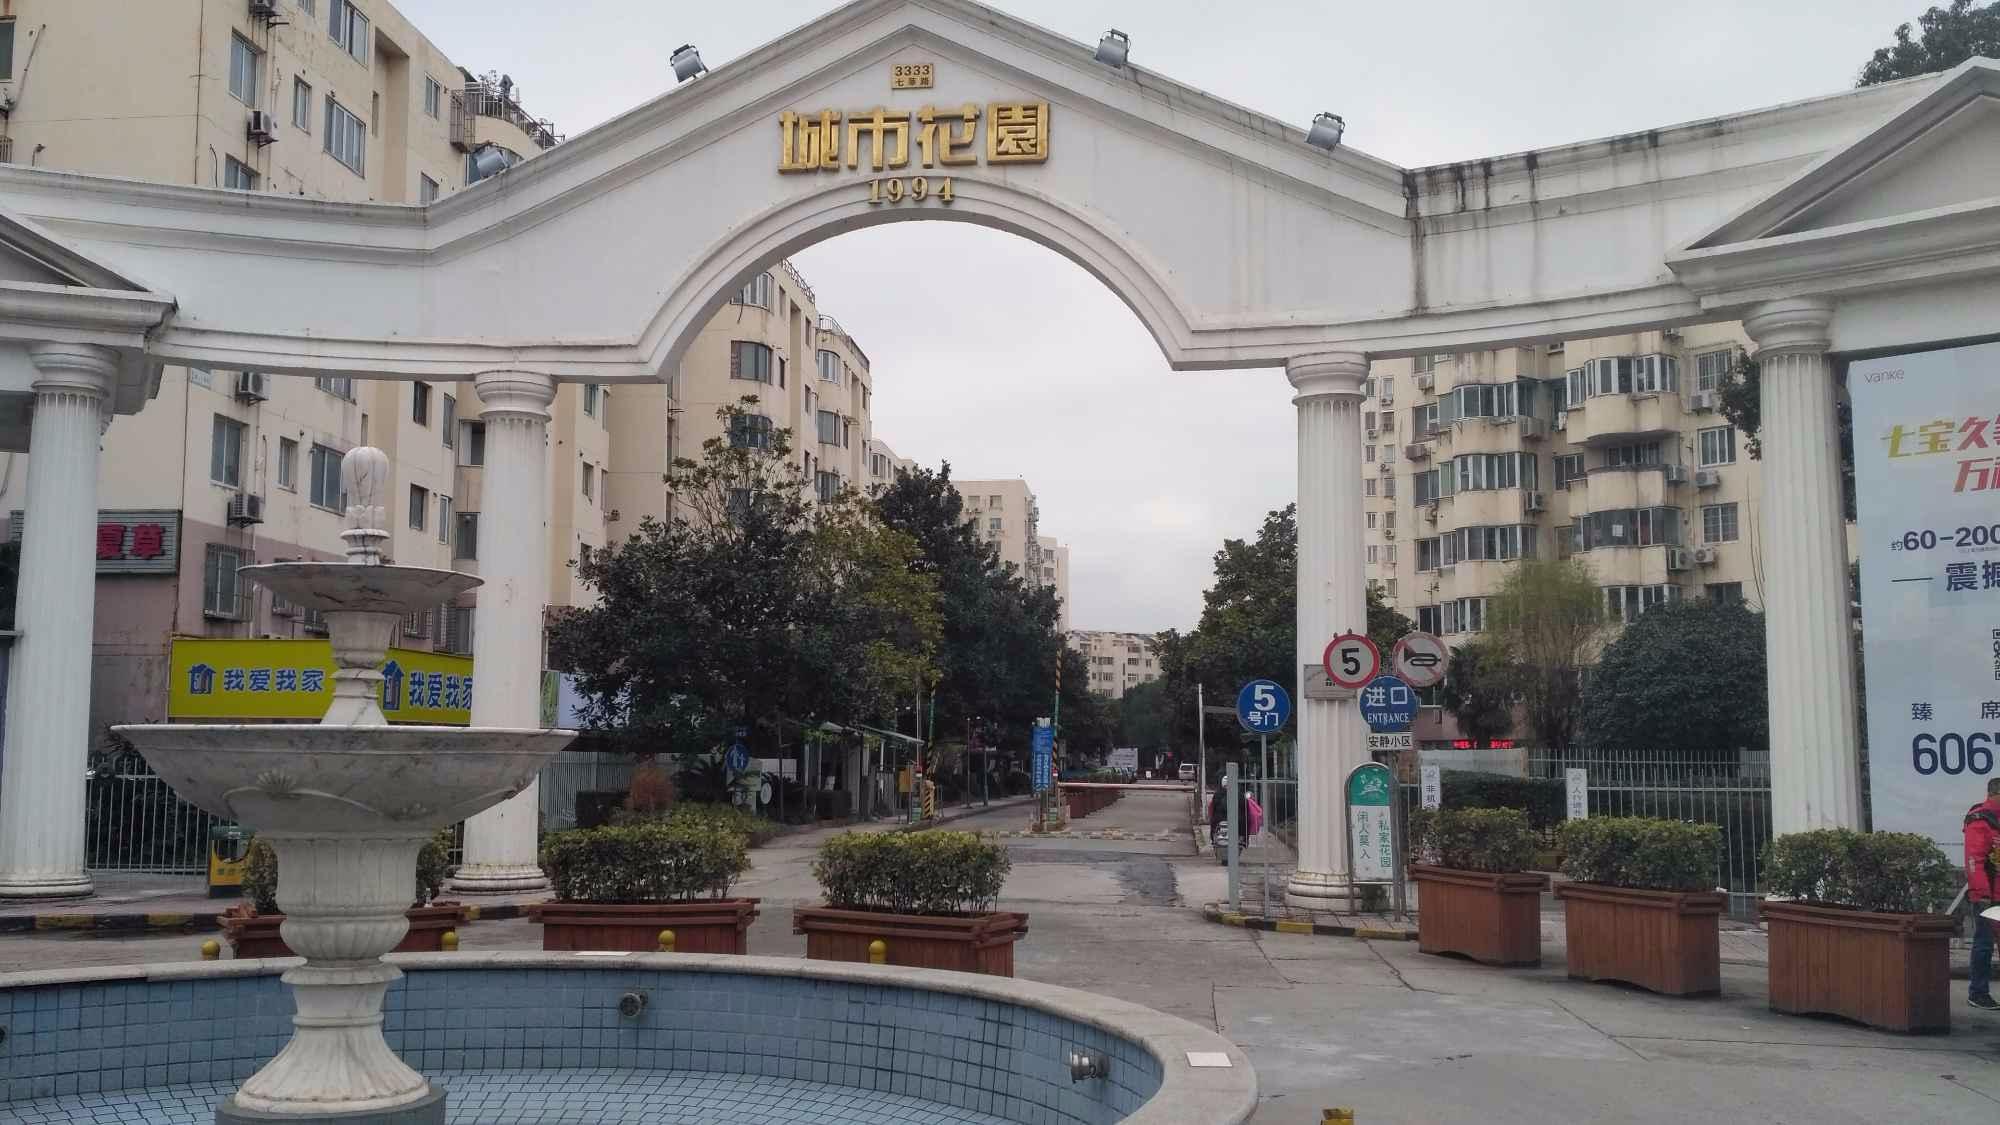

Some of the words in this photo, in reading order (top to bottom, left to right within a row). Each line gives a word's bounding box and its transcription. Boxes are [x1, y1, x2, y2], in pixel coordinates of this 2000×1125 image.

[895, 65, 930, 77] 3333
[869, 176, 953, 204] 1994
[1880, 415, 2000, 458] 七宝久
[1342, 647, 1361, 675] 5
[223, 668, 324, 692] 我爱我家
[1254, 684, 1276, 711] 5
[1366, 686, 1408, 707] 进口
[1247, 711, 1279, 726] 号门
[1367, 712, 1409, 724] ENTRANCE
[1368, 735, 1411, 749] 安静小区
[1912, 732, 2000, 775] 606
[1377, 818, 1392, 868] 私家花园
